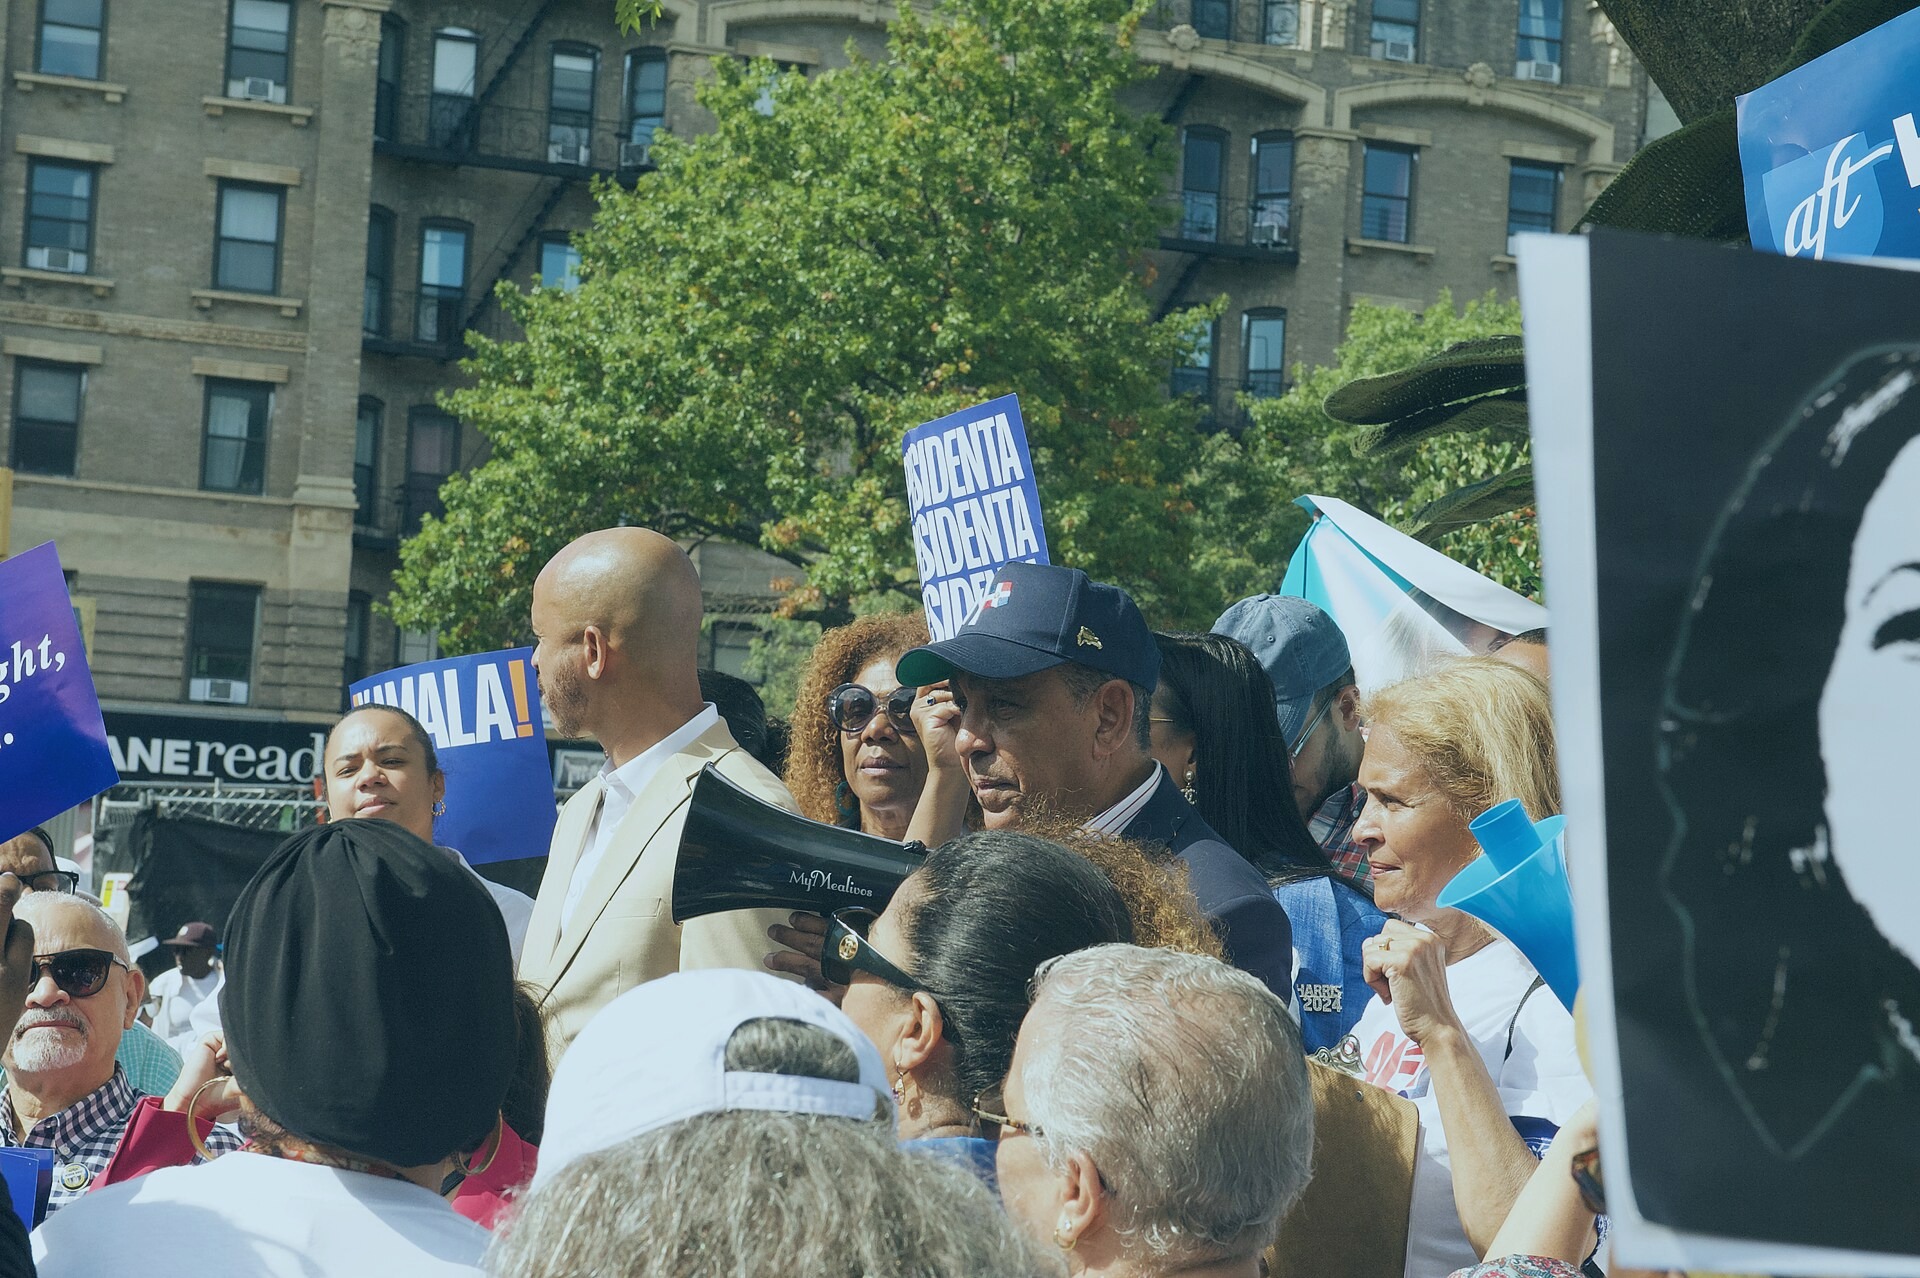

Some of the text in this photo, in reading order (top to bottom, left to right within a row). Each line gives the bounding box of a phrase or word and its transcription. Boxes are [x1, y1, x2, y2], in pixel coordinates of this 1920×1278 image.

[1784, 132, 1894, 260] aft
[904, 412, 1025, 520] SIDENTA
[912, 485, 1040, 589] SIDENTA
[789, 869, 873, 897] MyMealivos
[1296, 983, 1344, 998] HARRIS
[1303, 996, 1343, 1013] 2024
